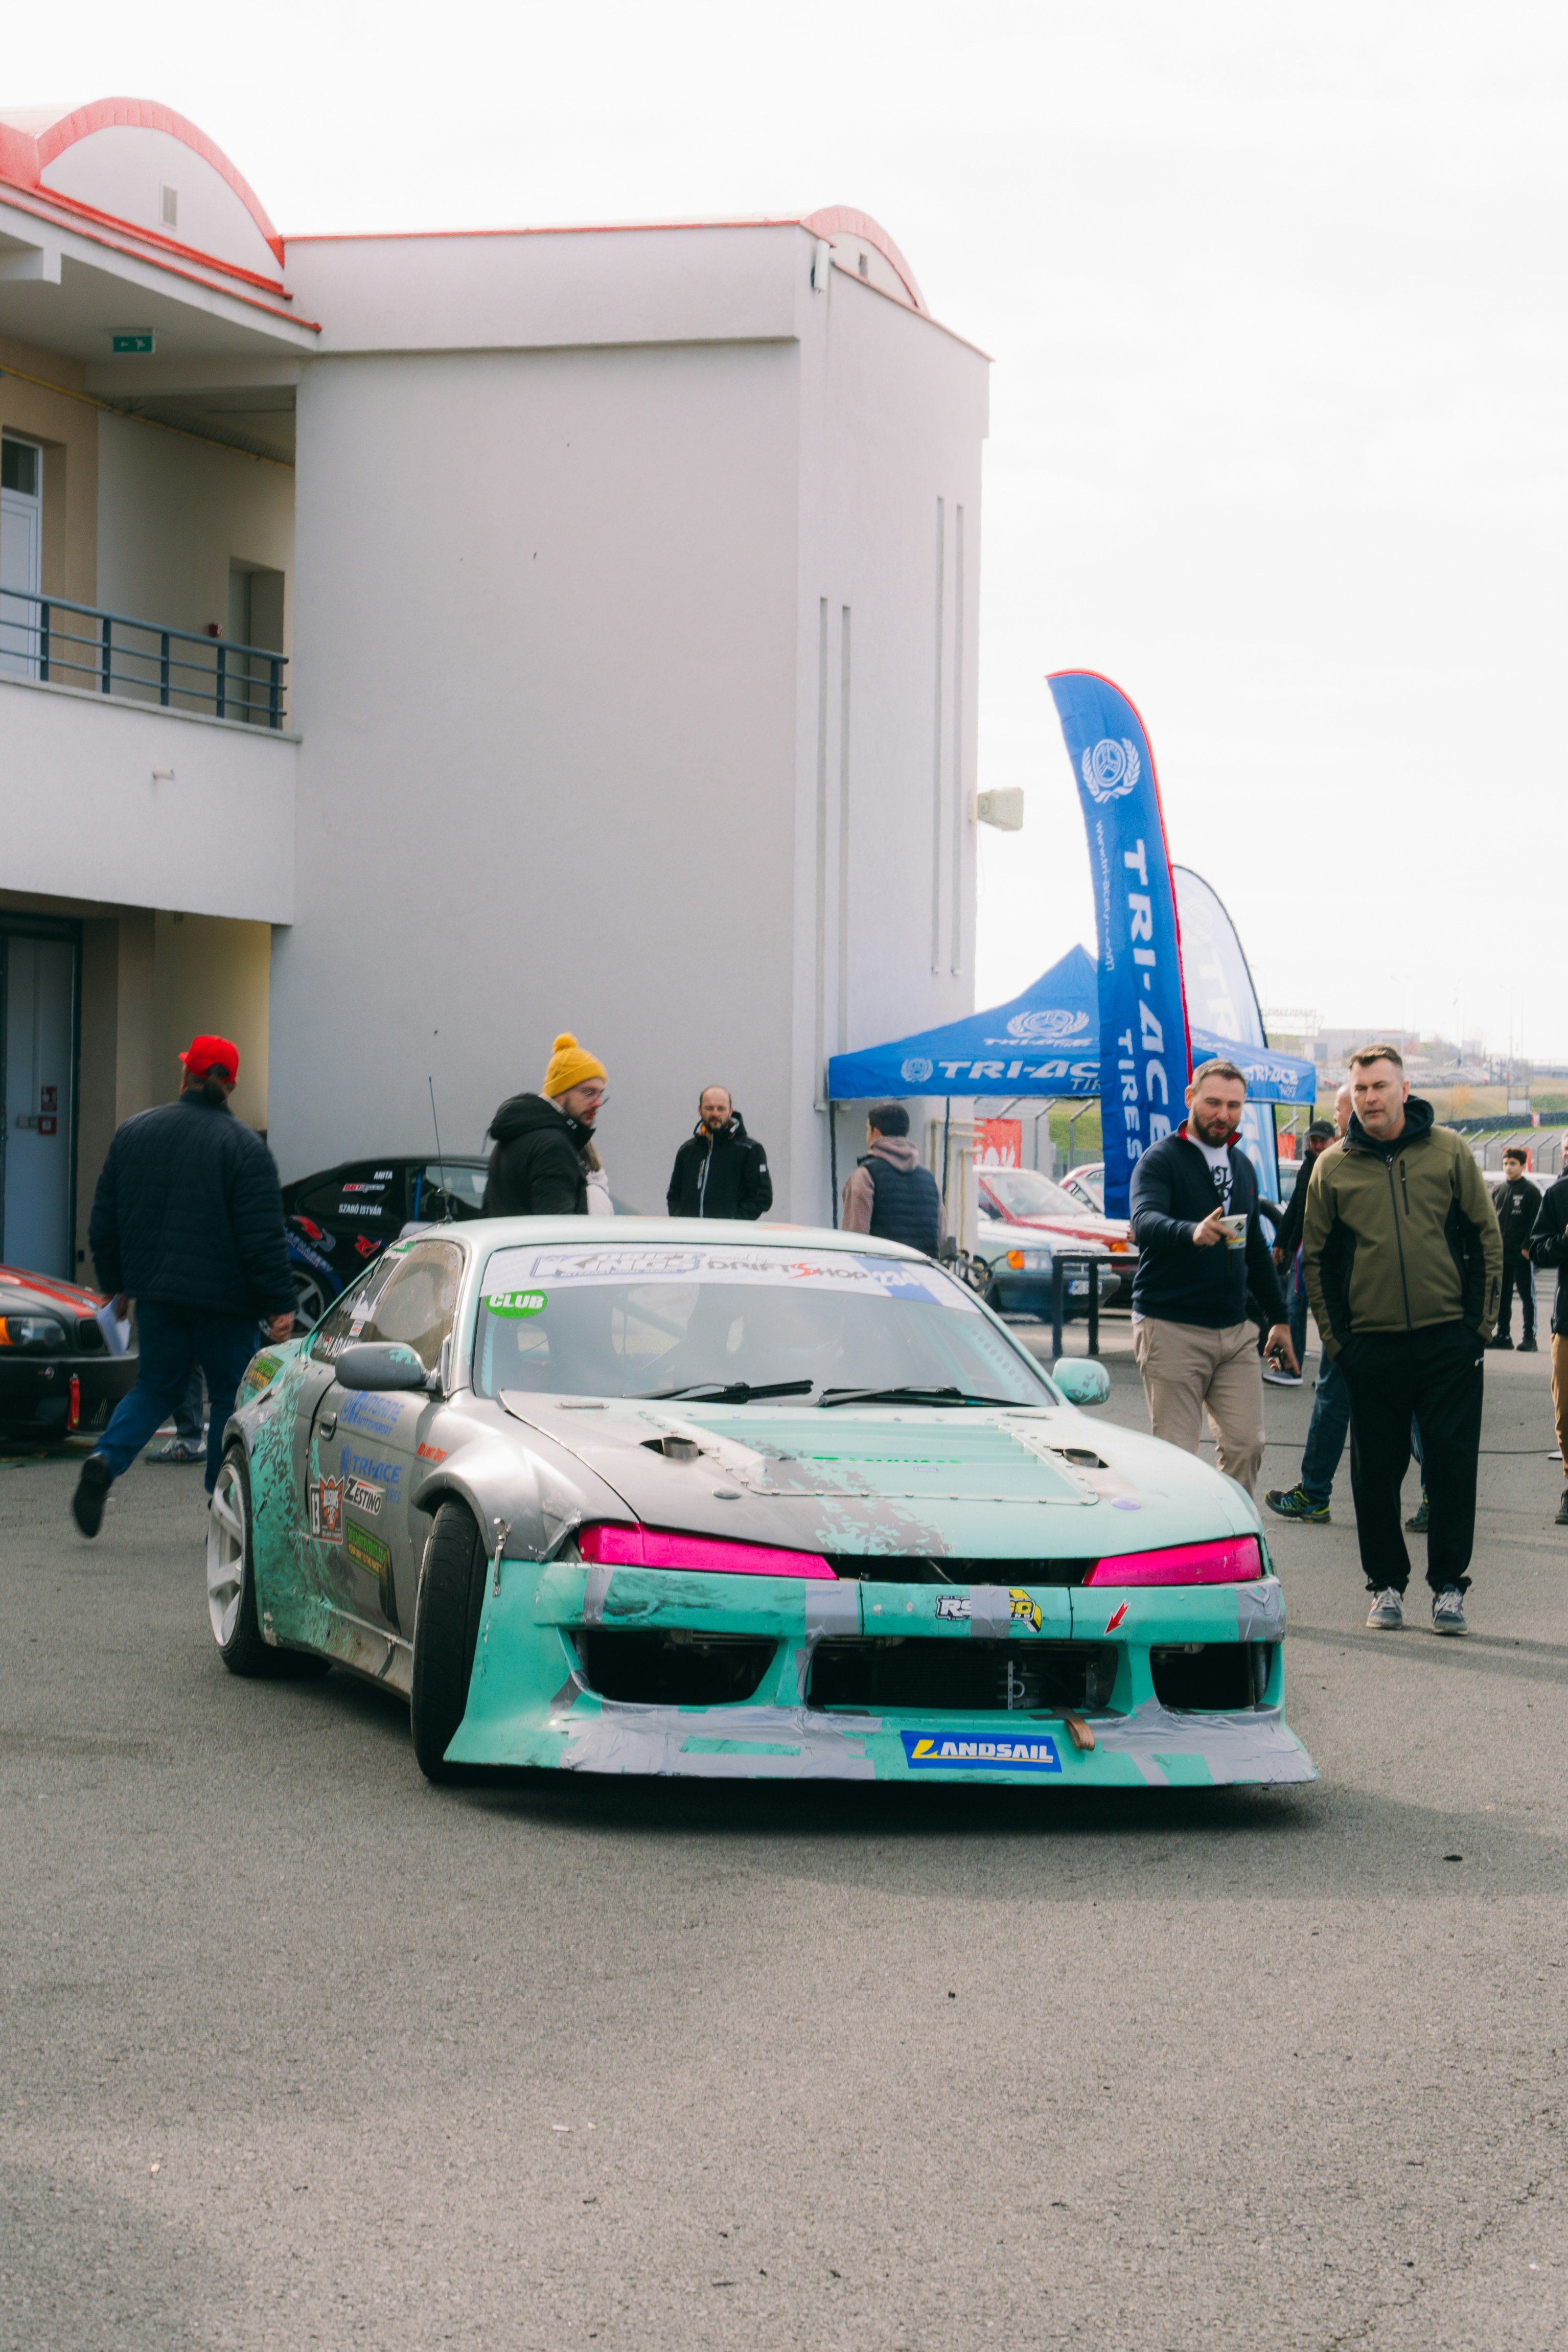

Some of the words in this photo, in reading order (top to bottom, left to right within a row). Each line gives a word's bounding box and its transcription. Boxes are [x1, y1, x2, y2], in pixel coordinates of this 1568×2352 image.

[1124, 839, 1171, 1146] TRI-ACE
[938, 1060, 1100, 1079] TRI-AC
[1070, 1078, 1100, 1091] TIR
[1118, 1028, 1143, 1160] TIRES
[374, 1171, 393, 1180] ANITA
[359, 1204, 382, 1216] ISTVÁN
[489, 1294, 544, 1309] CLUB
[352, 1456, 402, 1484] TRI-ACE
[344, 1478, 382, 1513] ZESTINO
[911, 1739, 1054, 1761] LANDSAIL
